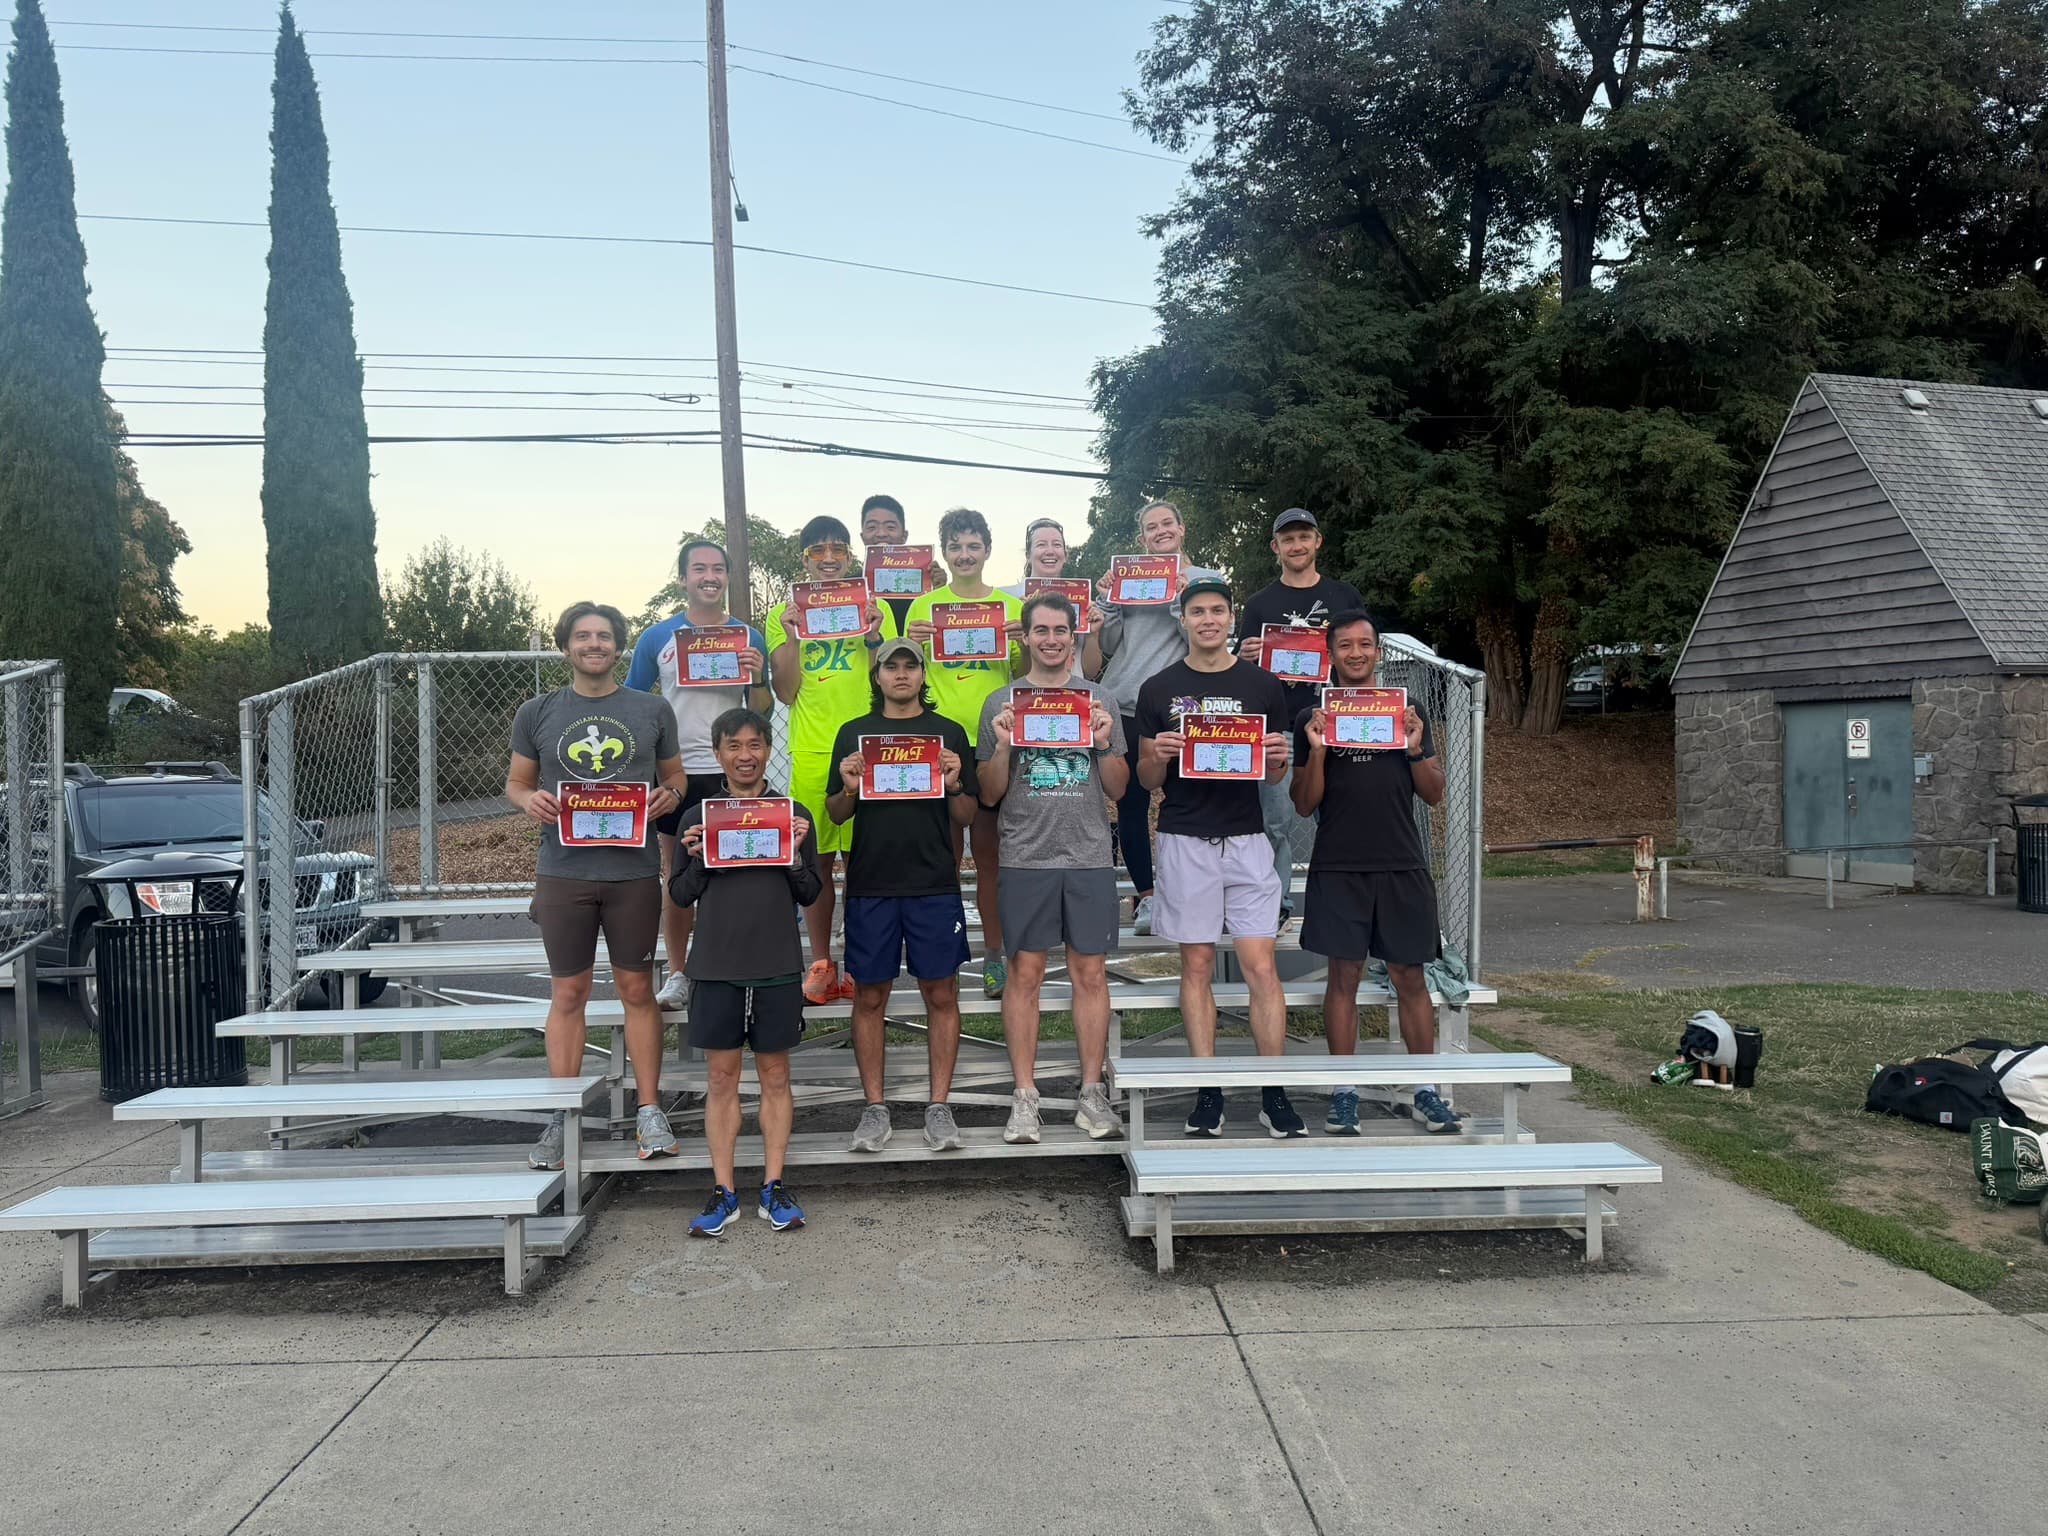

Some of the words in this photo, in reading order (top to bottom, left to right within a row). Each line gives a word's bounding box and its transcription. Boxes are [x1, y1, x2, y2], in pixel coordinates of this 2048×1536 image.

[946, 614, 991, 625] Rowell
[1203, 699, 1242, 712] DAWG
[1187, 724, 1259, 742] McKelvey
[880, 746, 925, 762] BMF
[1352, 755, 1373, 763] BEER
[567, 794, 639, 809] Gardiner
[736, 811, 765, 826] Lo
[1980, 1123, 1993, 1159] DAUNT
